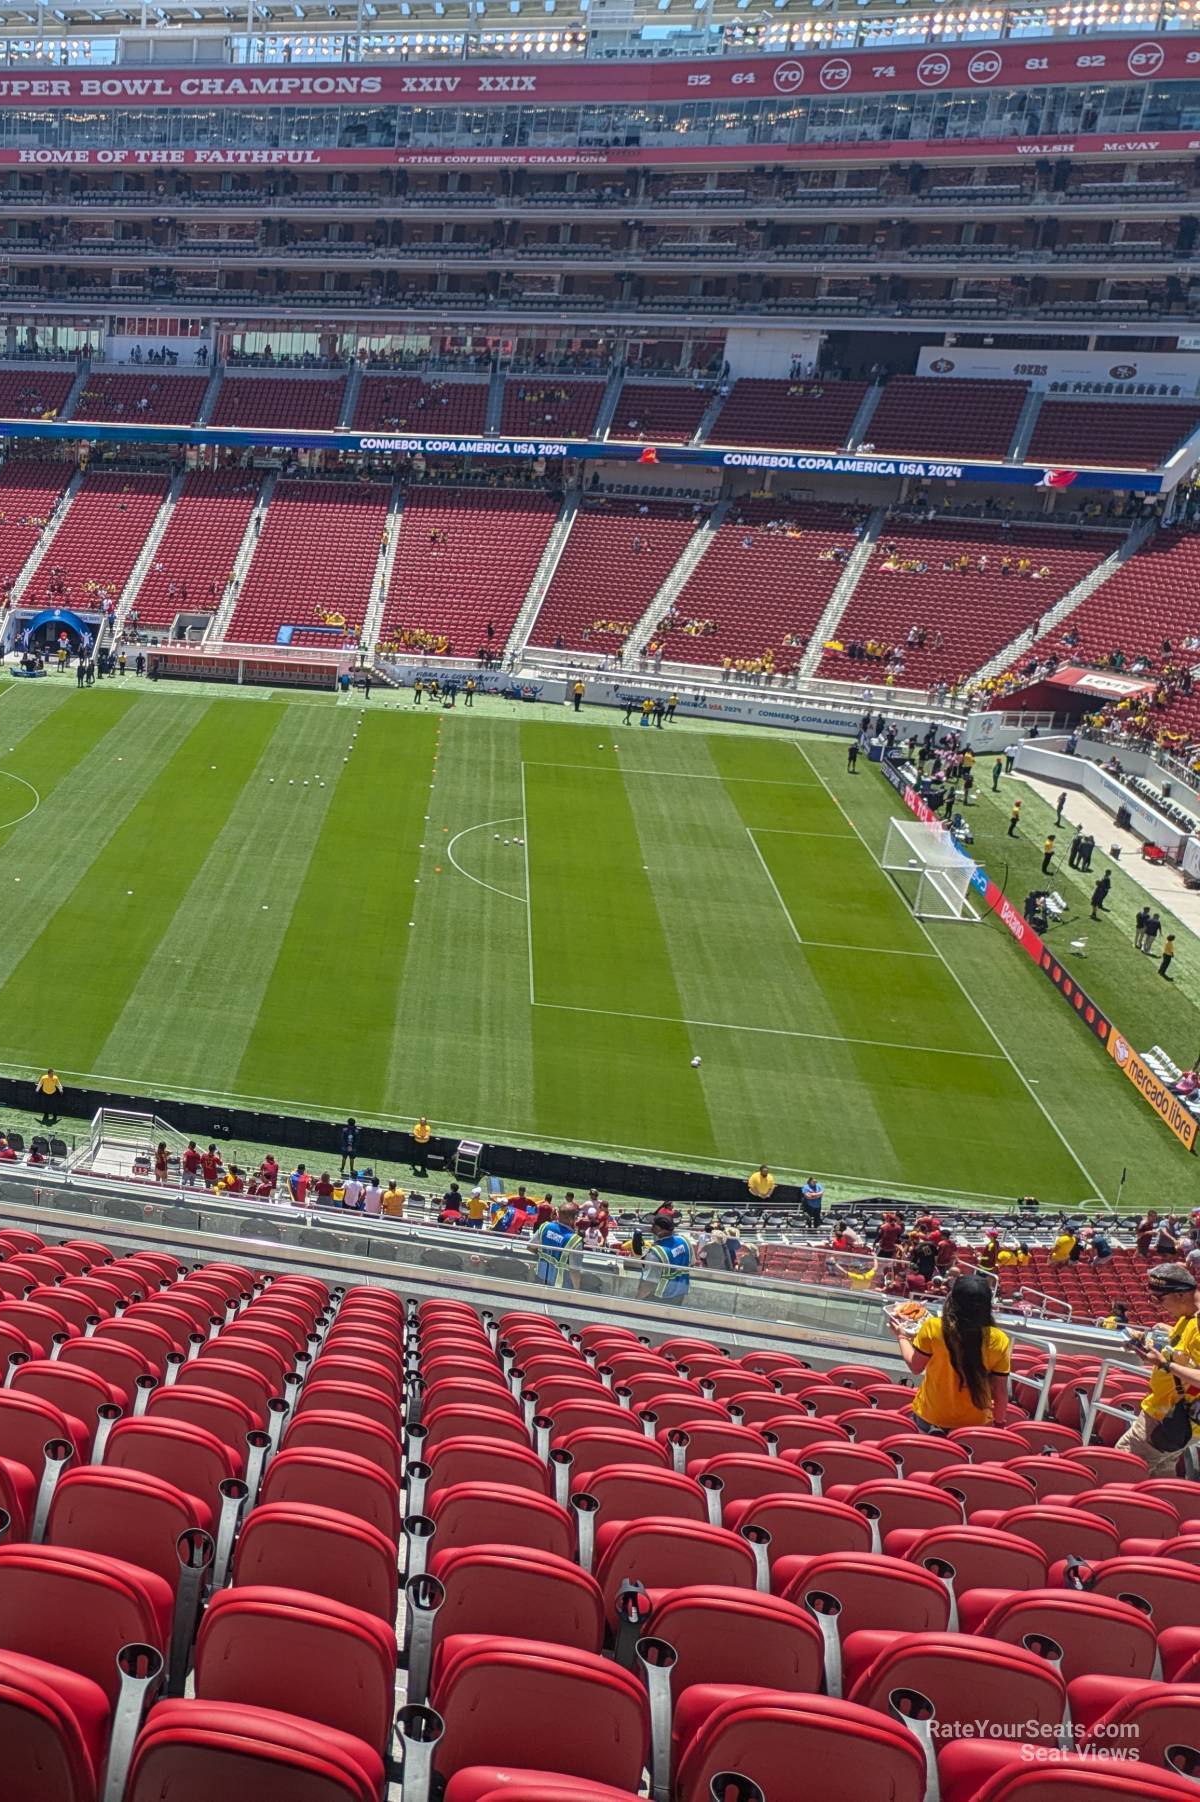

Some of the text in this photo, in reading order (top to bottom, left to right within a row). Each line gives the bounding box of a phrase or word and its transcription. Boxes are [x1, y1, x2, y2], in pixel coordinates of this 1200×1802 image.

[687, 51, 1200, 86] 52 64 70 73 74 79 80 81 82 87 9
[80, 79, 172, 96] BOWL
[180, 77, 382, 96] CHAMPIONS
[401, 77, 461, 92] XXIV
[477, 76, 536, 92] XXIX
[1017, 144, 1075, 154] WALSH
[1102, 142, 1160, 151] McVAY
[19, 150, 320, 163] HOME OF THE FAITHFUL
[444, 155, 527, 164] CONFERENCE
[529, 155, 608, 163] CHAMPIONS
[1013, 363, 1048, 377] 49ERS
[360, 438, 567, 456] CONMEBOL COPA AMERICA USA 2024
[723, 453, 962, 478] CONMEBOL COPA AMERICA USA 2024
[708, 703, 722, 711] USA
[724, 705, 742, 713] 2024
[801, 715, 822, 724] COPA
[823, 719, 858, 728] AMERICA
[1129, 1060, 1191, 1141] mercado libre
[133, 1166, 148, 1175] 112
